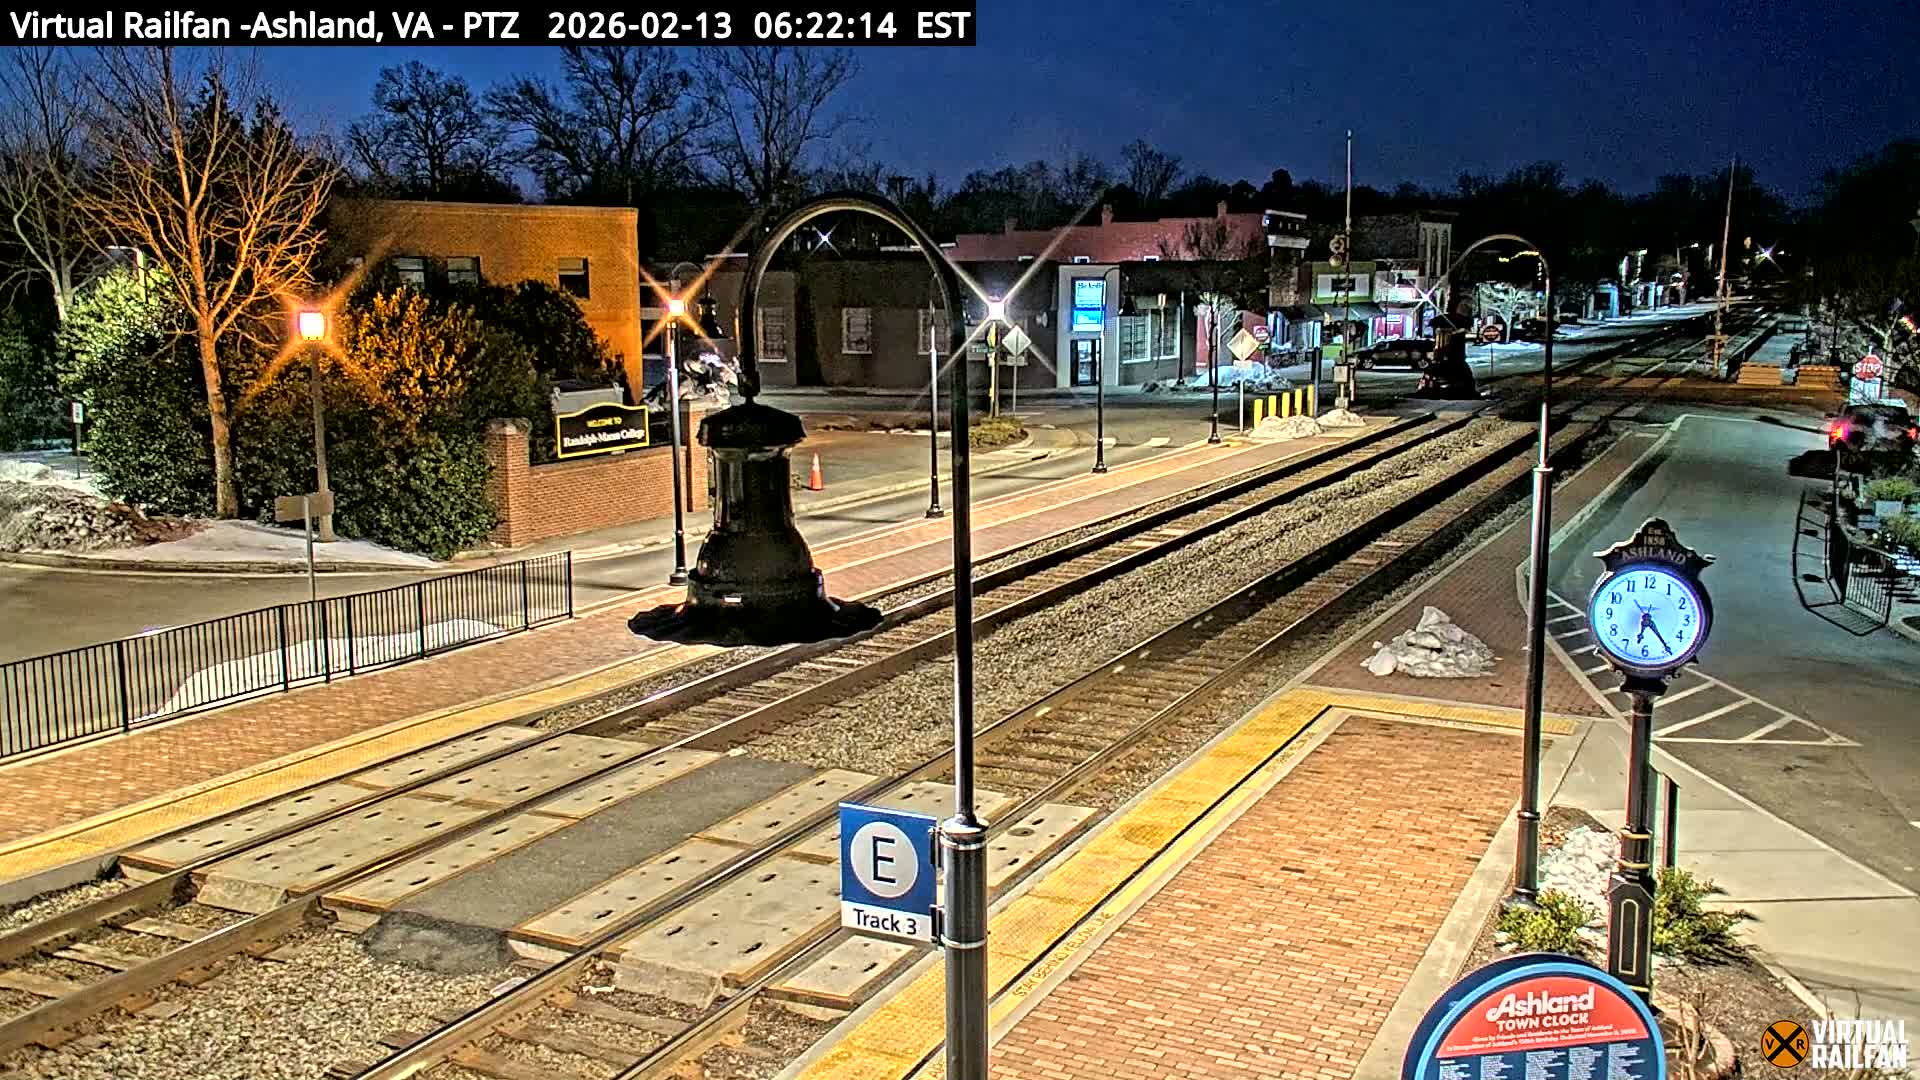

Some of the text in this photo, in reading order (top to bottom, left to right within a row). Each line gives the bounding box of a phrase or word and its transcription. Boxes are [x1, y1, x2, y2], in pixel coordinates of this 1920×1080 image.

[1855, 363, 1881, 373] STOP
[1622, 547, 1686, 565] ASHLAND
[1627, 580, 1636, 592] 11
[1644, 576, 1656, 589] 12
[1666, 583, 1671, 596] 1
[1611, 592, 1622, 604] 10
[1679, 597, 1686, 610] 2
[1606, 608, 1613, 619] 9
[1683, 615, 1690, 627] 3
[1609, 624, 1618, 636] 8
[1676, 630, 1684, 642] 4
[1621, 638, 1629, 651] 7
[1641, 645, 1649, 657] 6
[872, 836, 896, 884] E
[853, 908, 917, 935] Track 3
[1486, 985, 1595, 1022] Ashland
[1496, 1012, 1589, 1032] TOWN CLOCK
